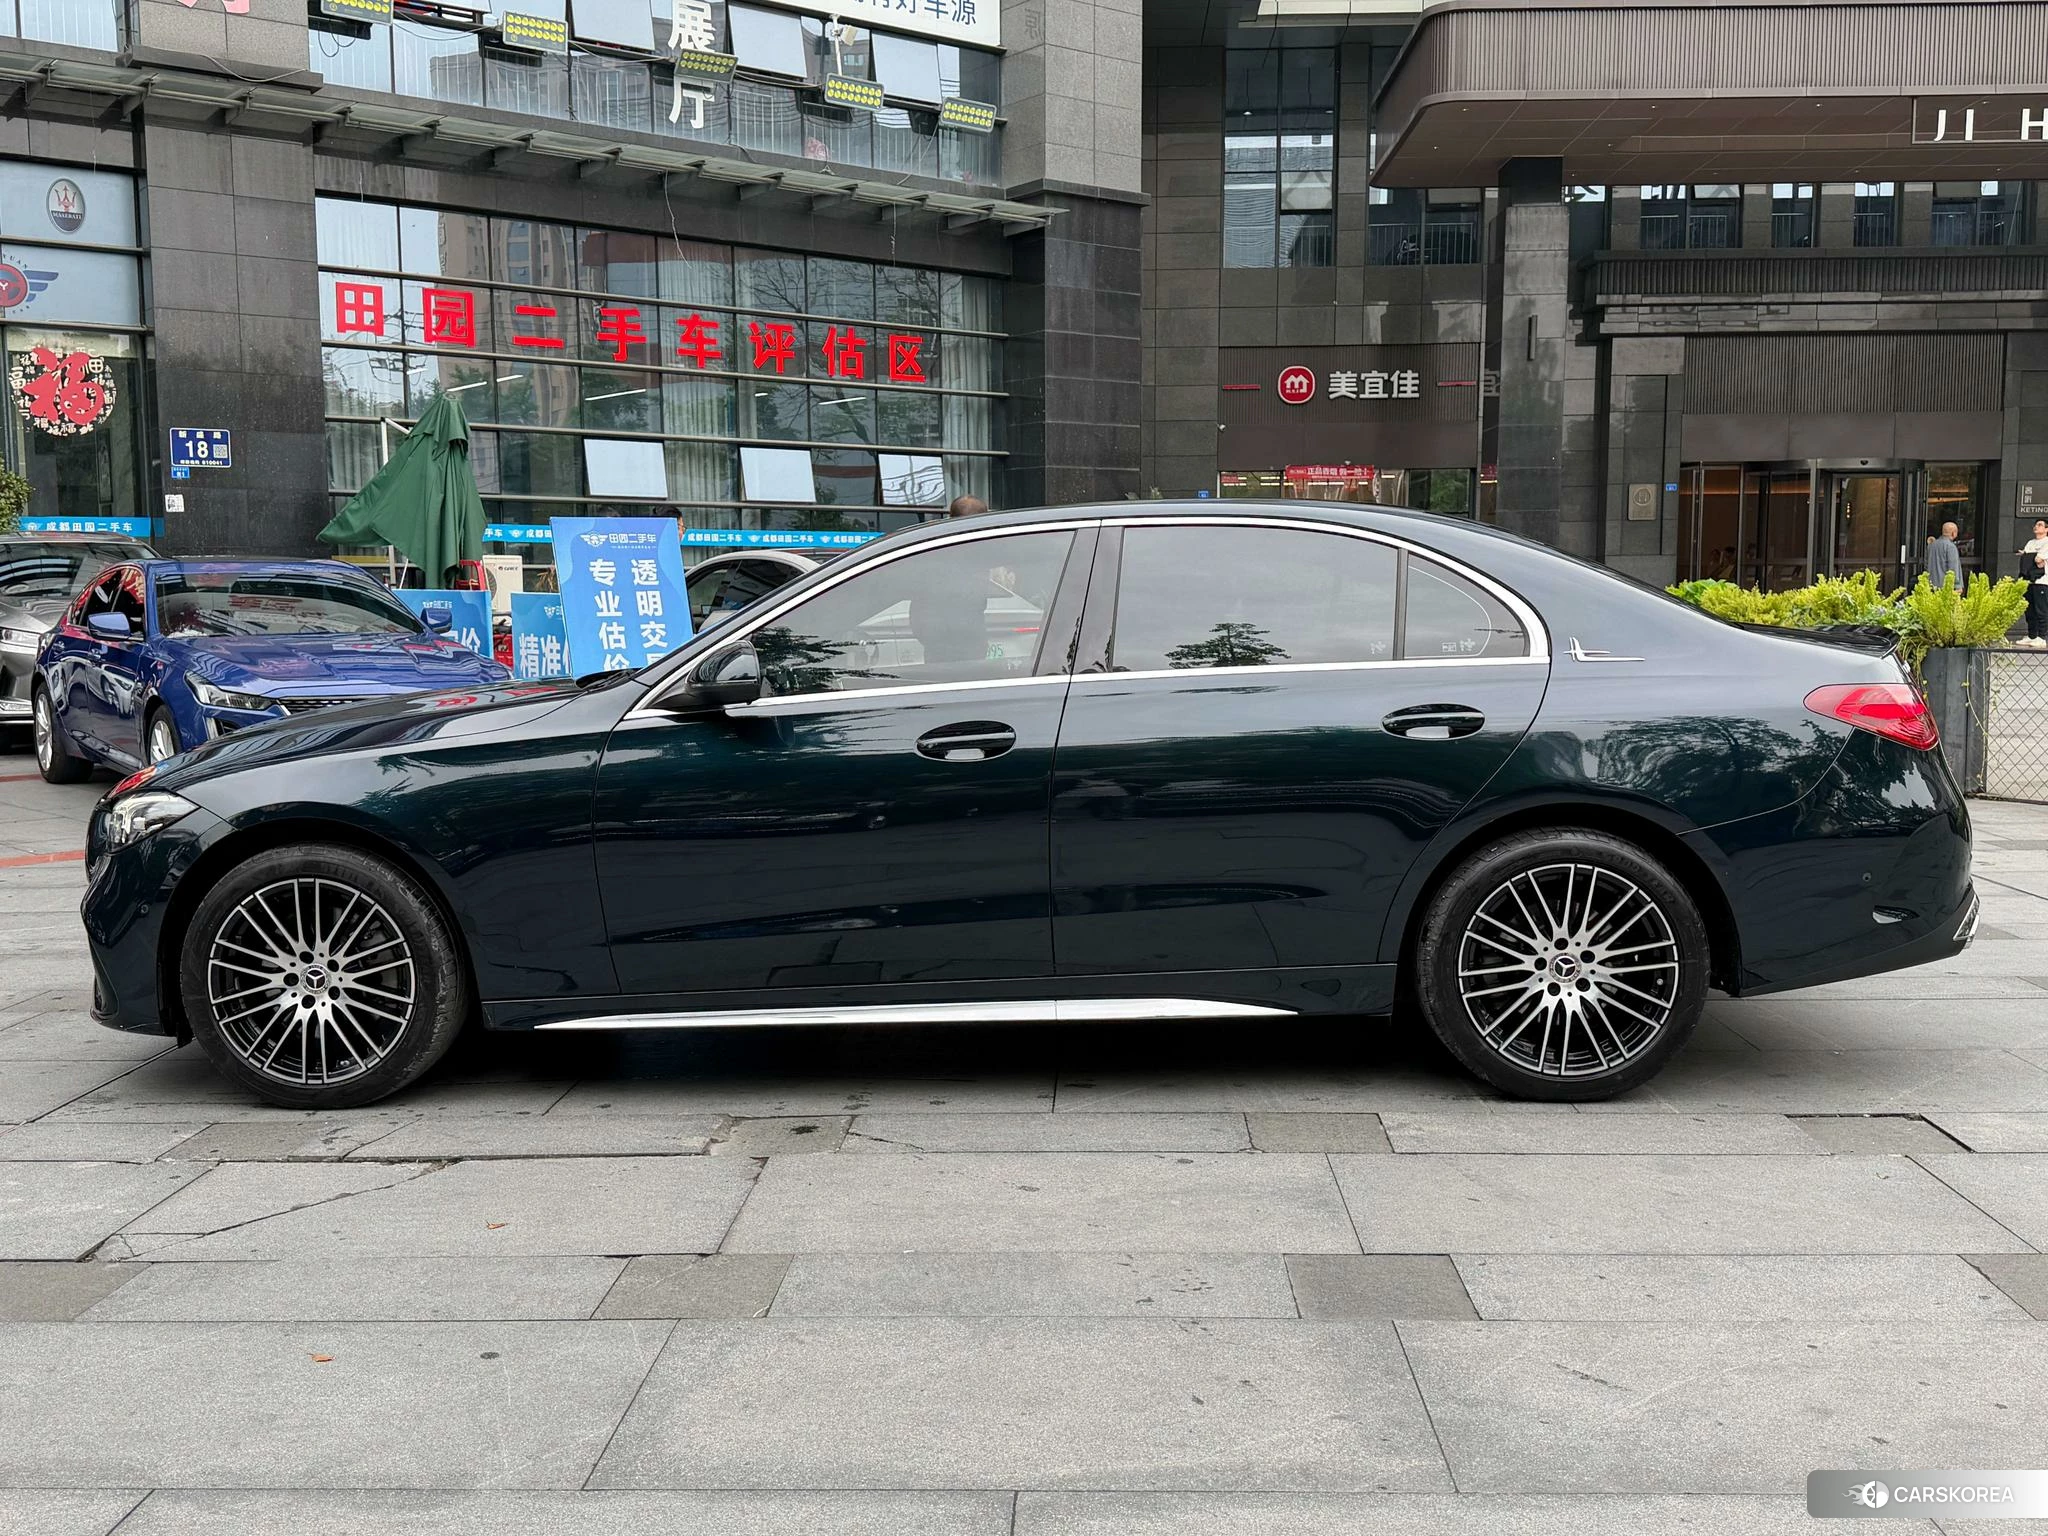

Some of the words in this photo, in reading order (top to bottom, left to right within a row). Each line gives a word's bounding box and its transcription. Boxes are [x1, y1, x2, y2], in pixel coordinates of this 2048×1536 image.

[1934, 108, 1974, 141] JI
[335, 281, 927, 384] 田园二手车评估区
[1328, 369, 1420, 399] 美宜佳
[185, 440, 209, 459] 18
